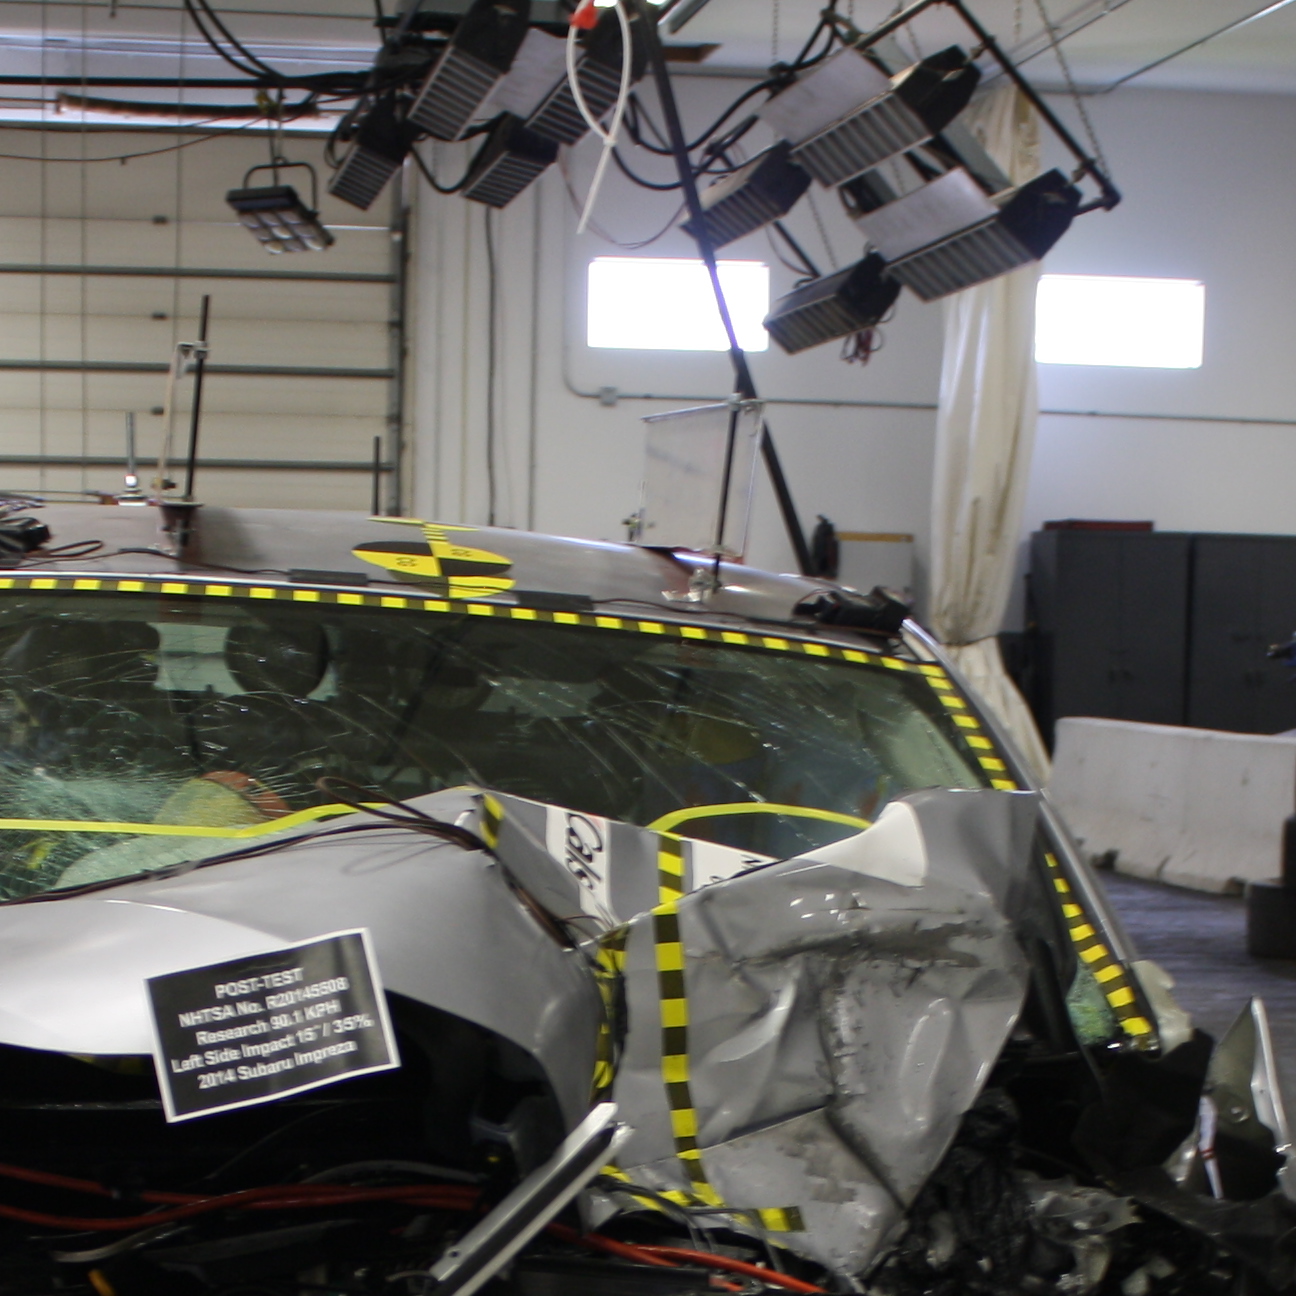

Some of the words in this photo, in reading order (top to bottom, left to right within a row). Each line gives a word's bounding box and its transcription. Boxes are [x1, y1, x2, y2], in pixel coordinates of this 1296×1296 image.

[178, 1004, 237, 1028] NHTSA
[235, 1001, 266, 1016] No.
[265, 976, 350, 1010] R20145508
[214, 967, 304, 999] POST-TEST
[170, 1053, 206, 1074] Left
[203, 1047, 243, 1066] Side
[240, 1034, 297, 1058] Impact
[331, 1013, 376, 1034] 35%
[195, 1019, 271, 1046] Research
[270, 1009, 304, 1031] 90.1
[304, 999, 342, 1021] KPH
[197, 1068, 239, 1090] 2014
[236, 1057, 297, 1080] Subaru
[293, 1040, 359, 1068] Impreza
